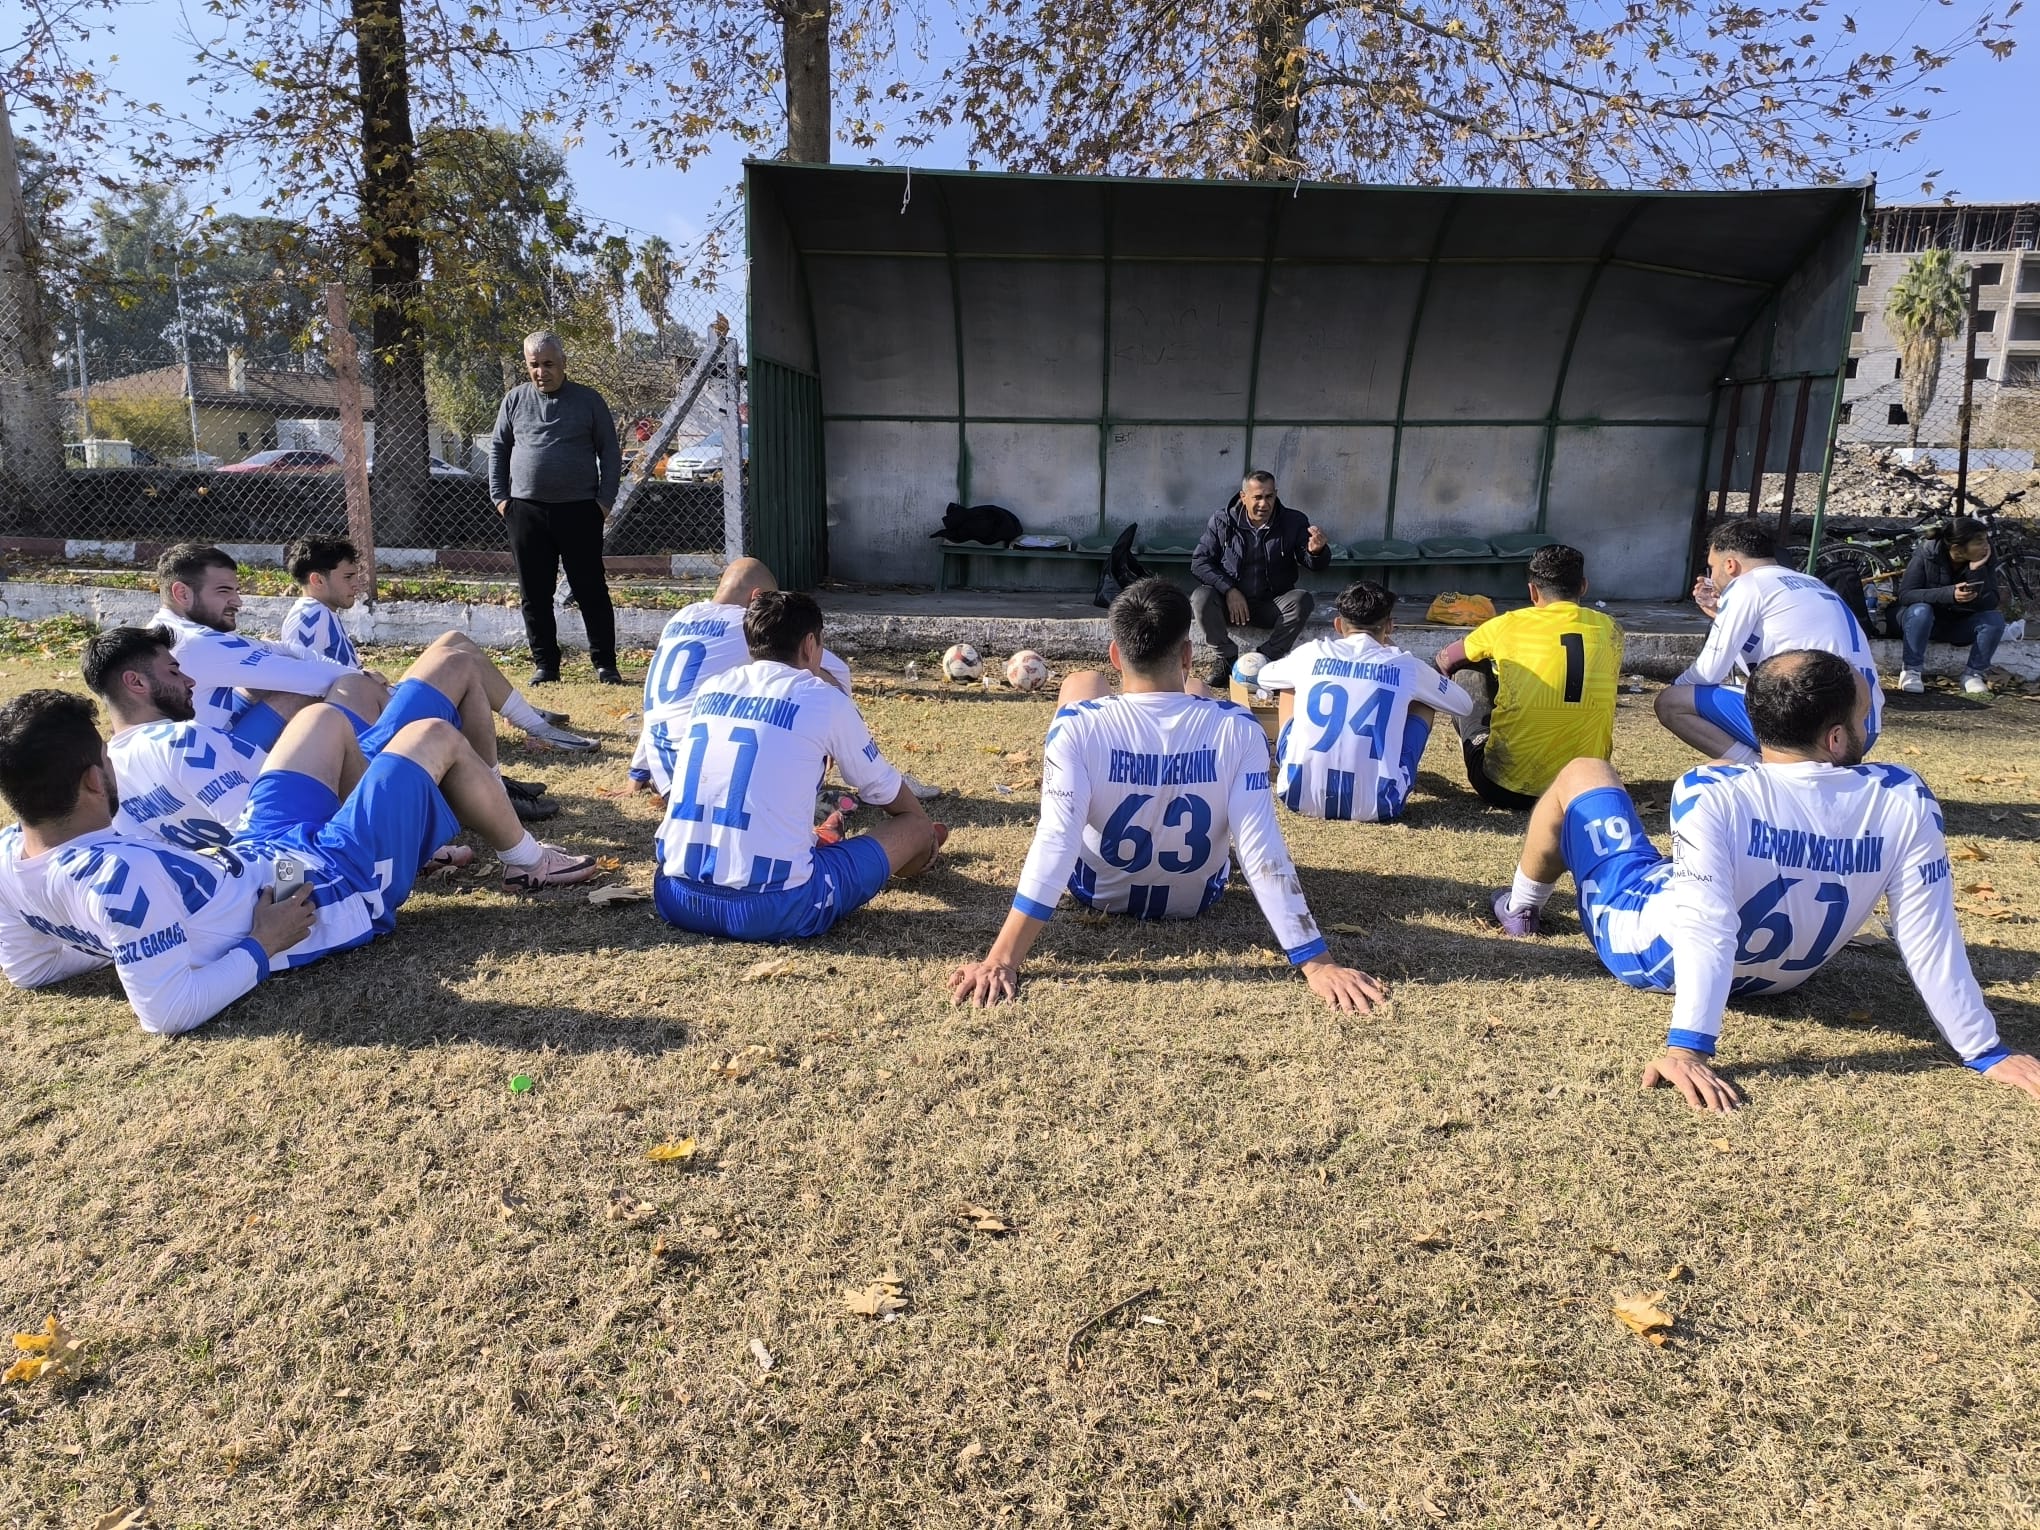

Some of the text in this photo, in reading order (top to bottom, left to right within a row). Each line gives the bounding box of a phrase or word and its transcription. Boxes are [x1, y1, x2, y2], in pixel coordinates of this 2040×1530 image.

[643, 639, 707, 713] 10
[1311, 656, 1401, 687] REFORM MEKANİK
[1560, 632, 1586, 704] 1
[730, 697, 801, 731] MEKANİK
[1306, 680, 1396, 761] 94
[671, 722, 759, 832] 11
[1108, 743, 1218, 787] REFORM MEKANİK
[1100, 793, 1212, 874] 63
[1734, 873, 1850, 971] 61
